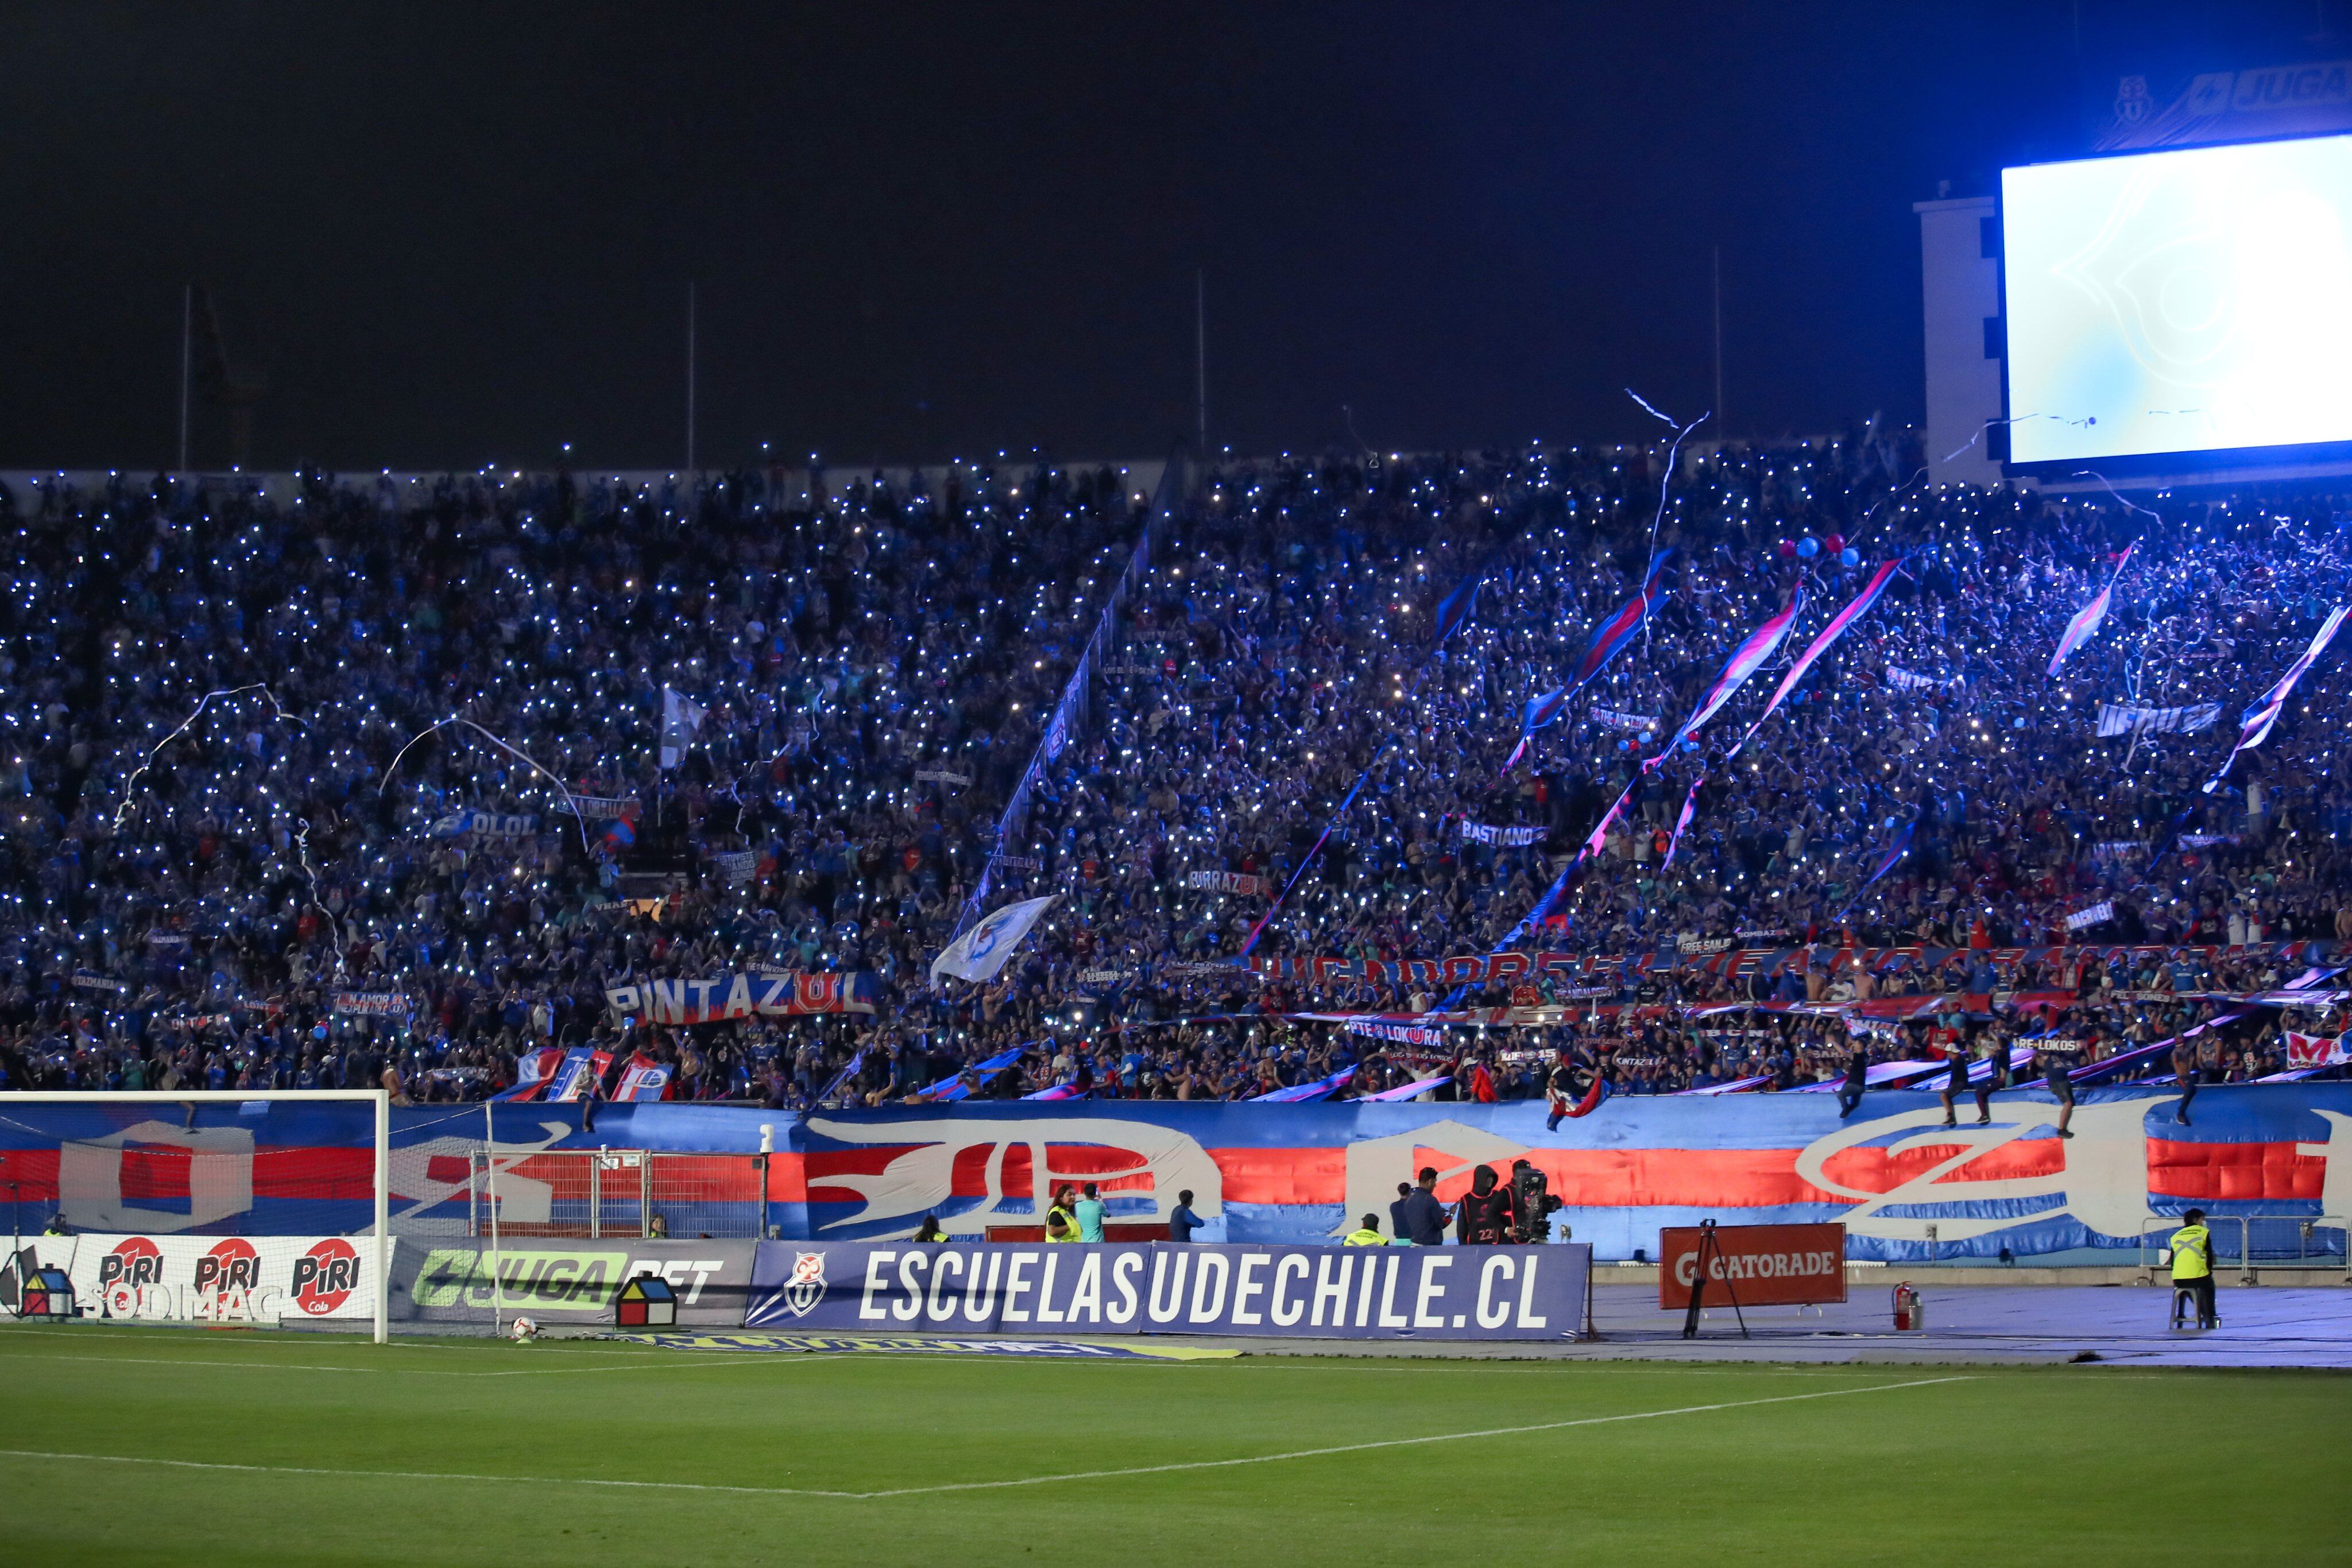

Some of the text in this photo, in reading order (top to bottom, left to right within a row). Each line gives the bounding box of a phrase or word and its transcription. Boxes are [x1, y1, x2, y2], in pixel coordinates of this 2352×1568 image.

[1463, 820, 1535, 846] BASTIANO
[605, 972, 875, 1031] PINTAZUL
[1349, 1021, 1373, 1037] PTE
[1386, 1024, 1441, 1047] LOKURA
[2038, 1039, 2076, 1051] LOKOS
[1479, 1229, 1493, 1241] 22
[1709, 1252, 1835, 1281] GATORADE
[480, 1259, 608, 1303] JUGA
[859, 1250, 1548, 1329] ESCUELASUDECHILE.CL
[76, 1282, 282, 1322] SODIMAC
[308, 1300, 330, 1313] Cola
[794, 1284, 817, 1308] U
